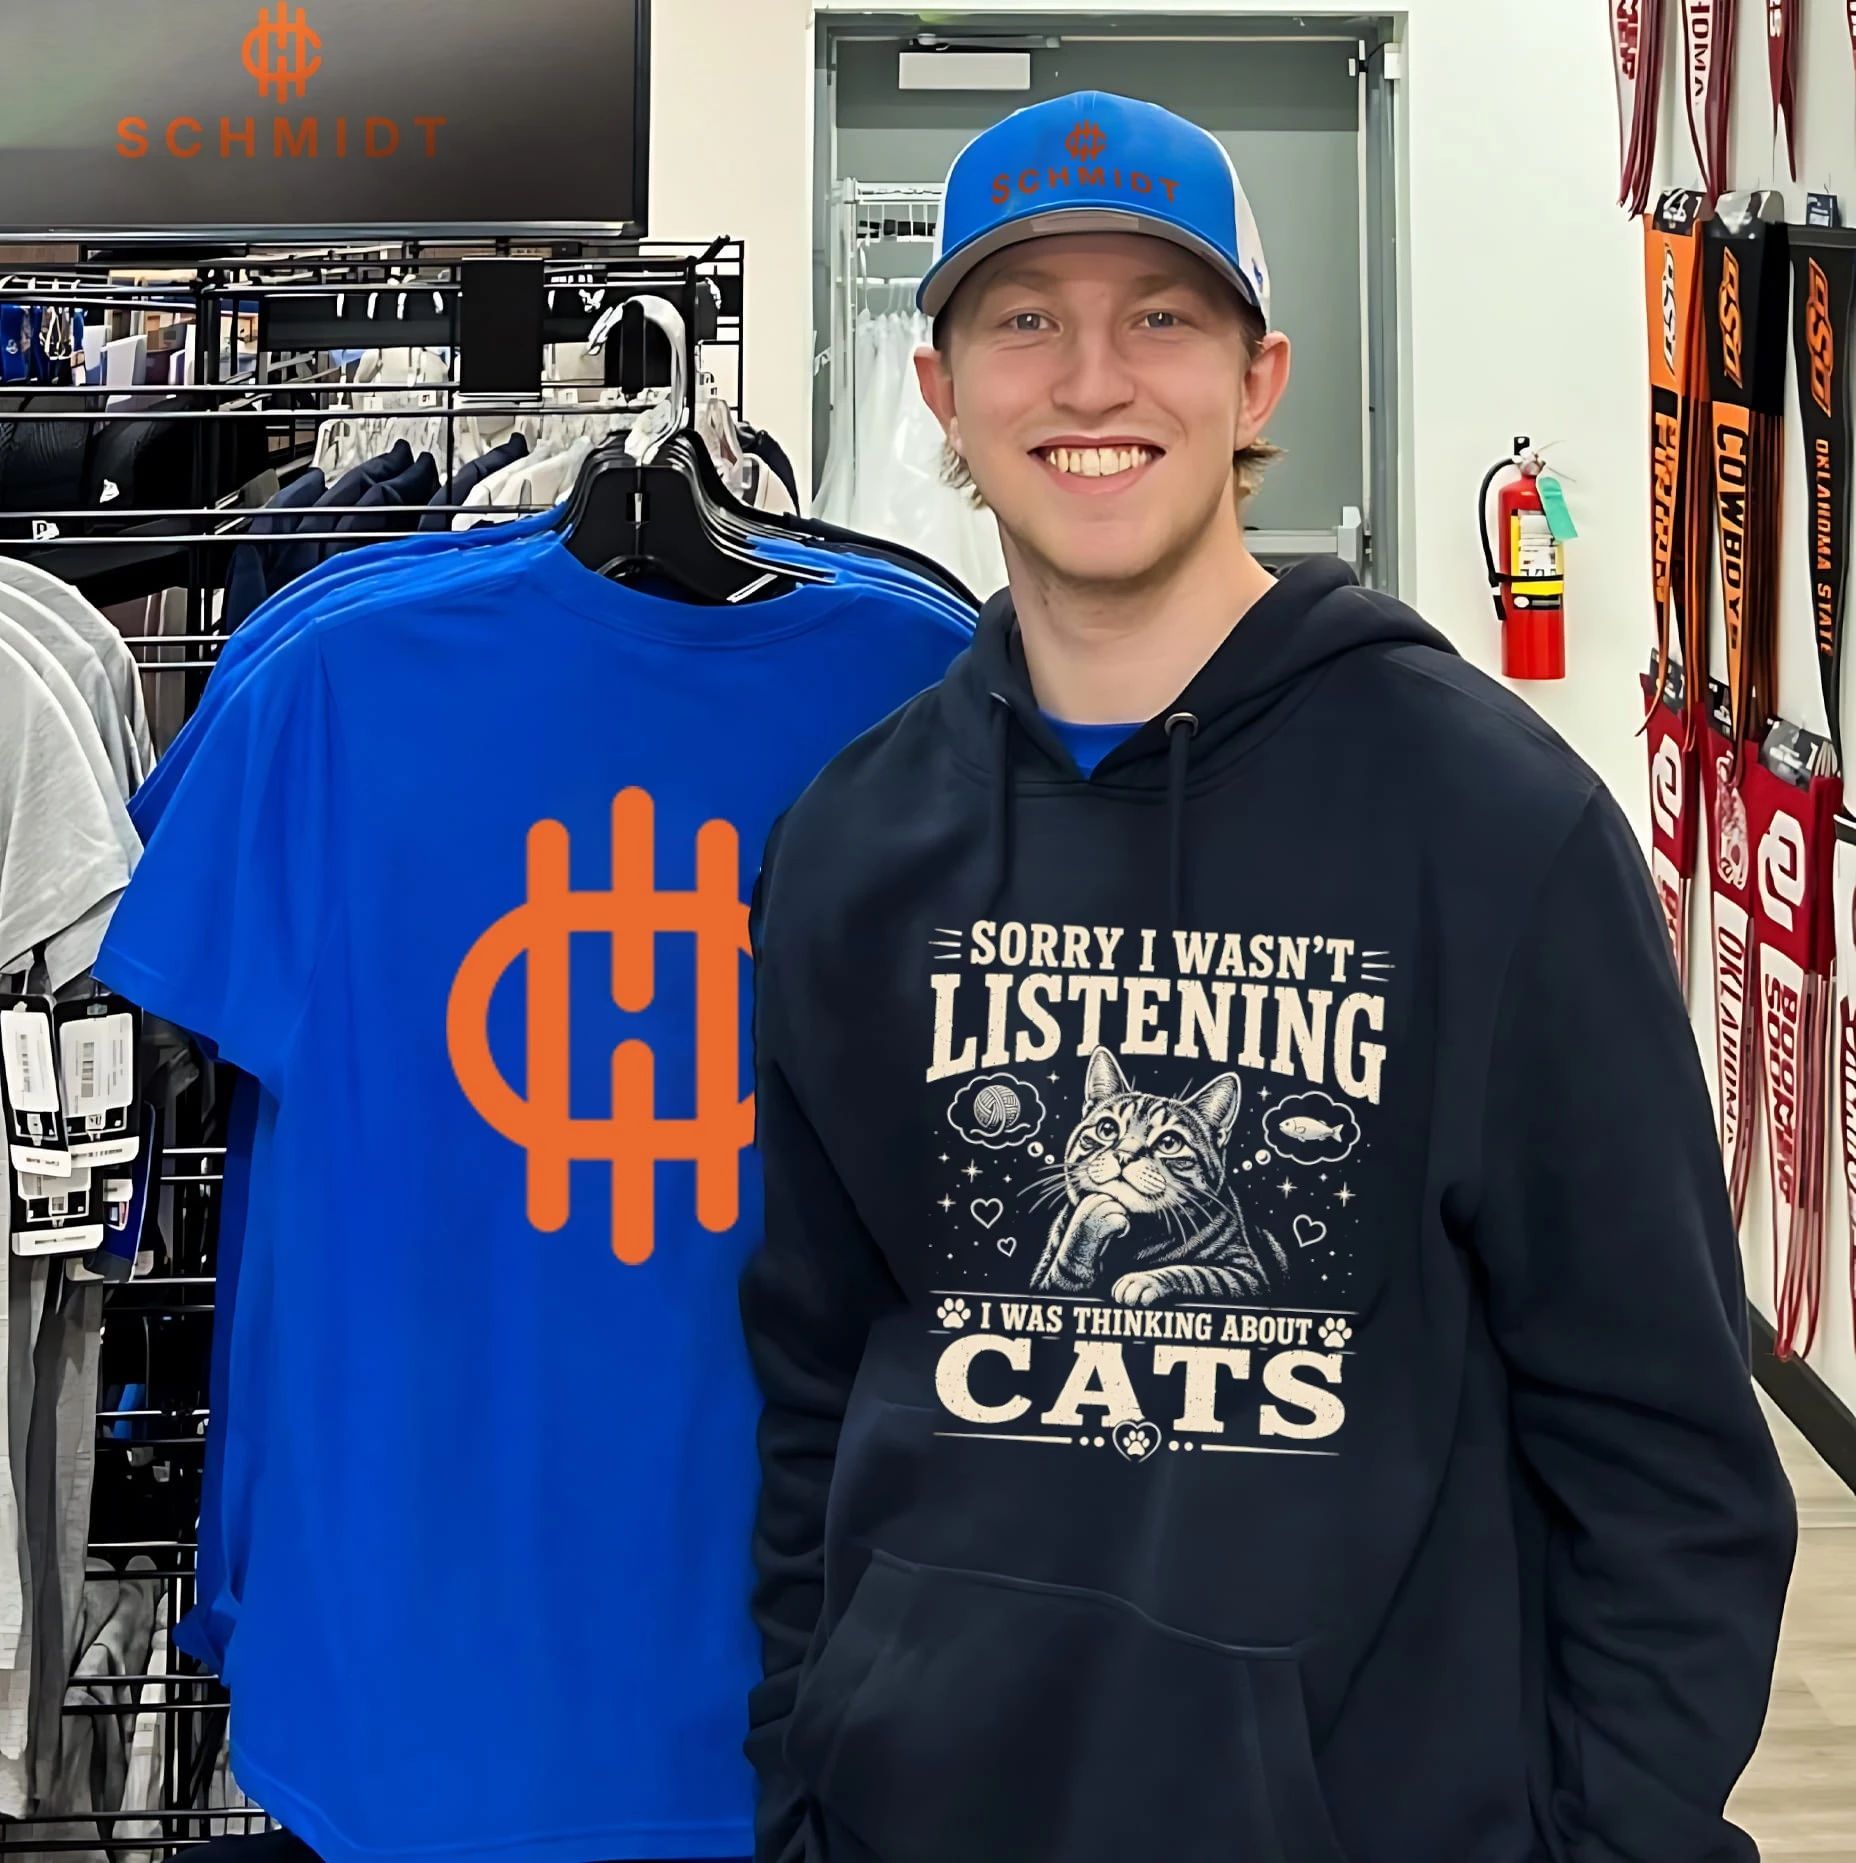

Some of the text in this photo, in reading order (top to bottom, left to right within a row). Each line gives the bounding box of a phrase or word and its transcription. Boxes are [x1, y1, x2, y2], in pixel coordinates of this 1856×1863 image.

[115, 116, 448, 159] SCHMIDT
[991, 167, 1181, 205] SCHMIDT
[1715, 423, 1747, 649] COWBOY
[1815, 438, 1832, 570] OKLAHOMA
[970, 919, 1354, 983] SORRY I WASN'T
[925, 973, 1387, 1105] LISTENING
[980, 1302, 1313, 1346] I WAS THINKING ABOUT
[934, 1333, 1346, 1440] CATS
